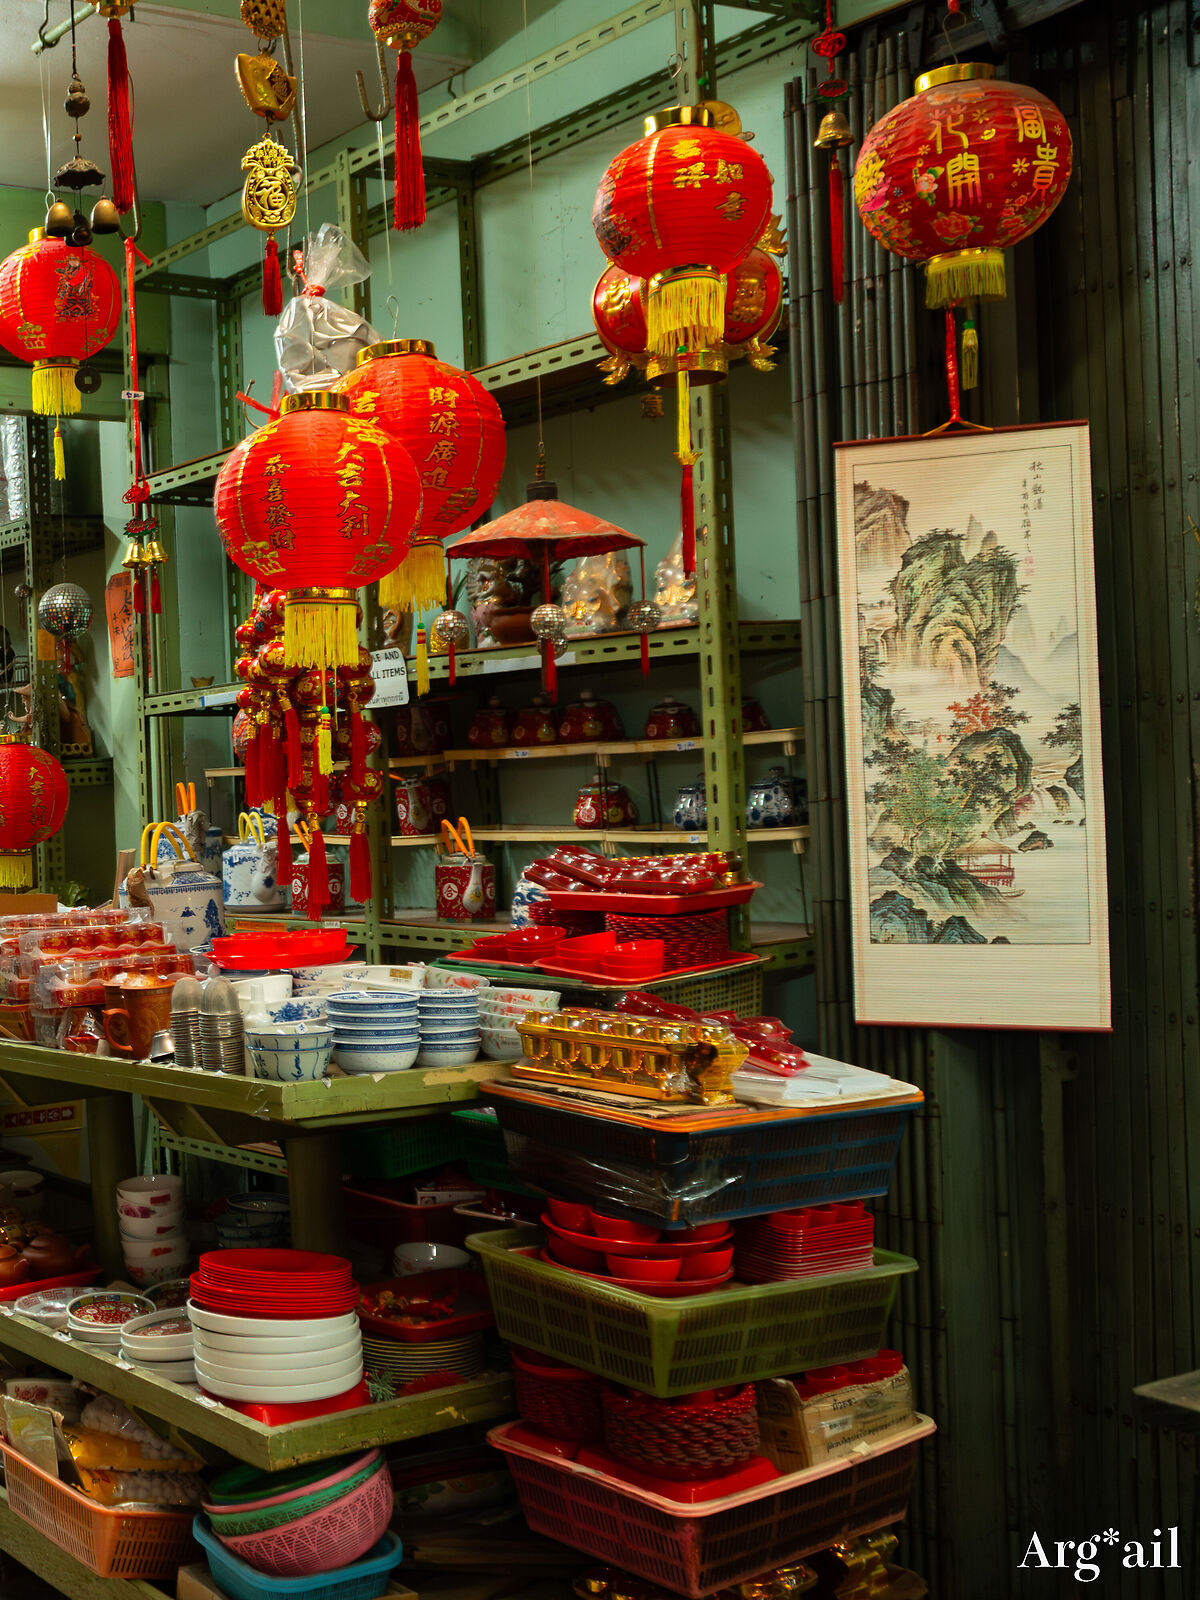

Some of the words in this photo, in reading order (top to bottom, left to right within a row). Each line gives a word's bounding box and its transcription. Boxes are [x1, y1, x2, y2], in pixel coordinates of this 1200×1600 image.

[254, 180, 287, 210] 福
[928, 104, 983, 209] 花開
[422, 386, 461, 491] 財源廣進
[261, 454, 295, 551] 恭喜發財
[334, 441, 369, 539] 大吉大利
[382, 667, 406, 679] ITEMS
[384, 651, 400, 661] AND
[26, 766, 47, 827] 大吉大利
